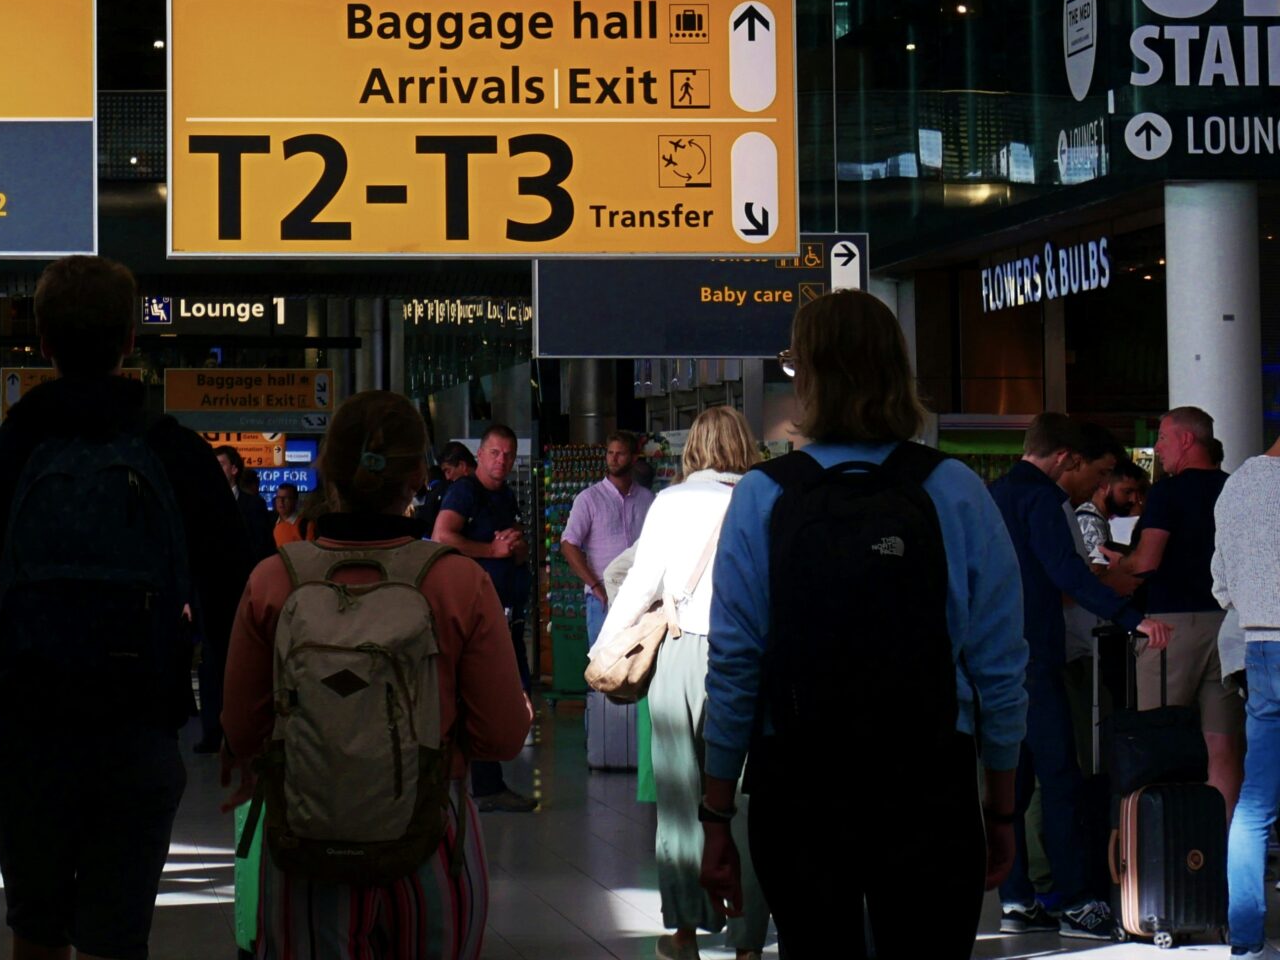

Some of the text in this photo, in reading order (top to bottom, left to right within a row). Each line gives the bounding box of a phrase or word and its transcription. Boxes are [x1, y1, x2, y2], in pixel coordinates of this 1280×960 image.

[347, 1, 657, 49] Baggage hall
[1079, 2, 1091, 22] MED
[1129, 25, 1280, 87] STAI
[359, 66, 658, 105] Arrivals Exit
[1186, 115, 1280, 156] LOUN
[188, 133, 575, 243] T2-T3
[589, 203, 714, 228] Transfer
[980, 235, 1111, 315] FLOWERS & BULBS
[700, 285, 793, 307] Baby care
[180, 297, 286, 325] Lounge 1
[196, 373, 295, 389] Baggage hall
[200, 393, 295, 407] Arrivals Exit
[283, 470, 308, 481] FOR
